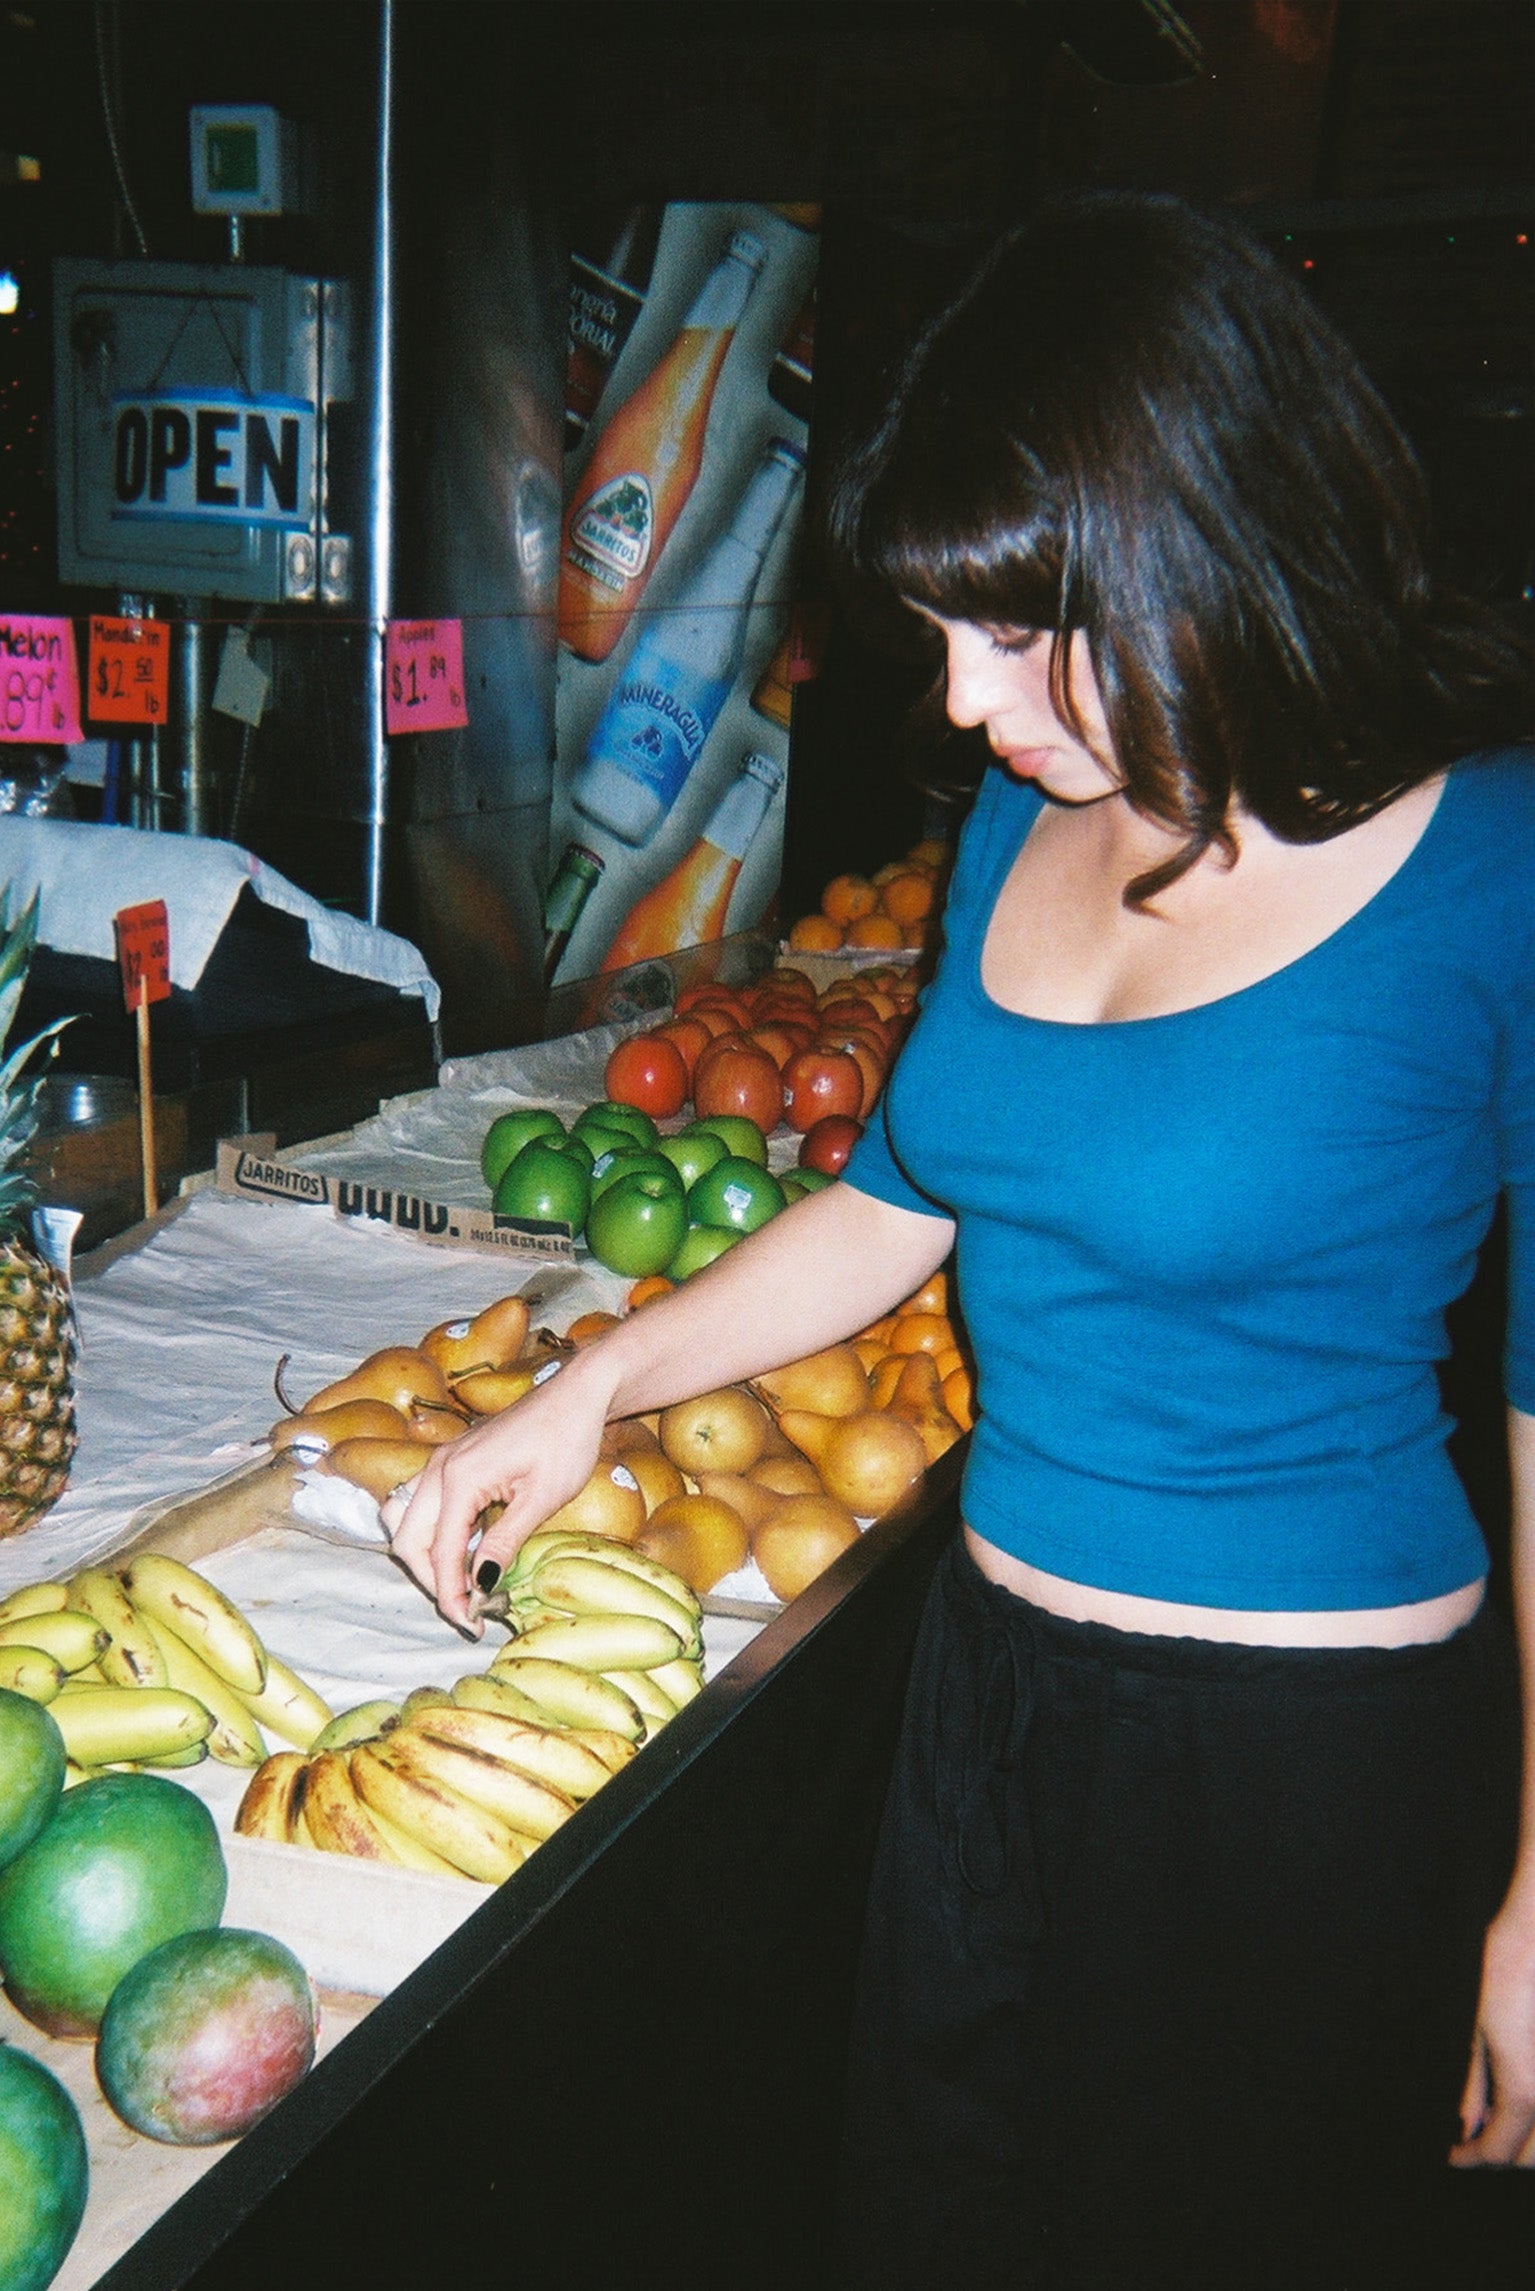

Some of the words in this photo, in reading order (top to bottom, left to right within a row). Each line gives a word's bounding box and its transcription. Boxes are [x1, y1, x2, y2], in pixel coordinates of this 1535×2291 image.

[115, 408, 299, 513] OPEN
[580, 521, 636, 562] JARRITOS
[0, 626, 62, 661] Melon
[145, 690, 159, 714] lb
[619, 684, 701, 750] MINERAGUA
[243, 1161, 319, 1196] JARRITOS
